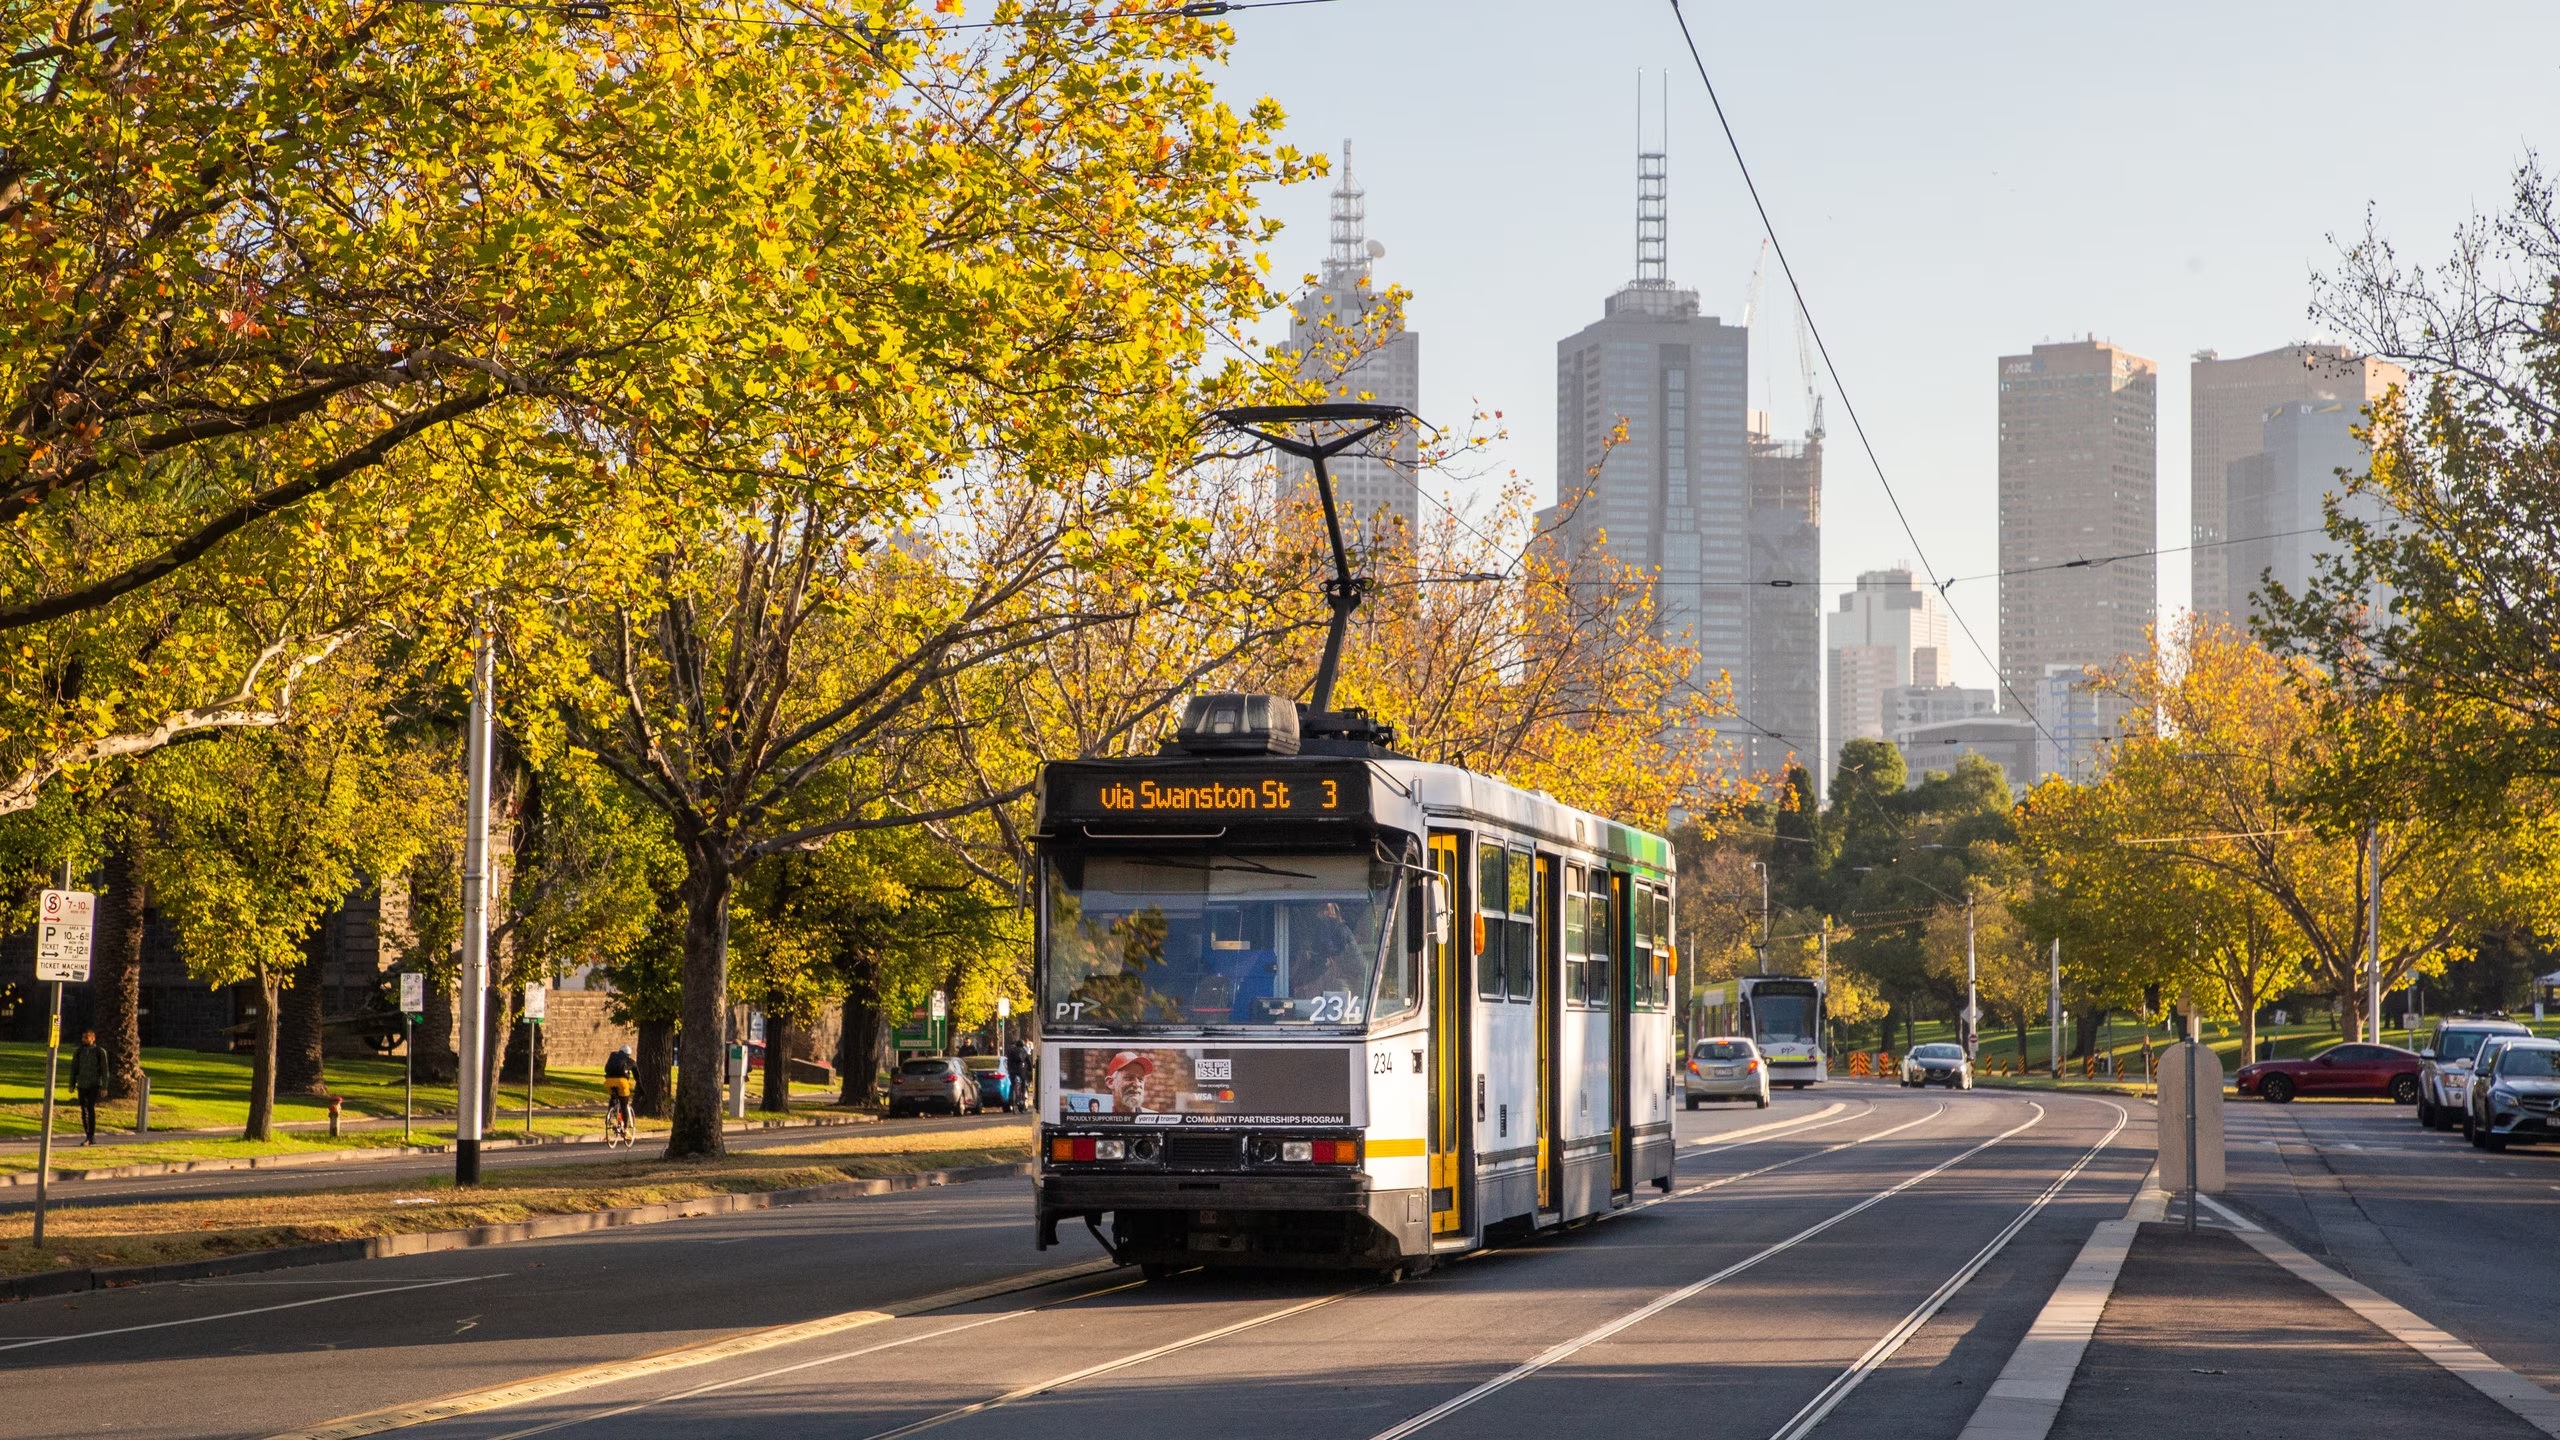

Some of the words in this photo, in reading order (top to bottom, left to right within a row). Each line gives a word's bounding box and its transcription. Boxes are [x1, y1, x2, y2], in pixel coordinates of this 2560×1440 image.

[2005, 362, 2032, 374] ANZ
[1101, 782, 1134, 809] via
[1140, 780, 1256, 809] Swanston
[1262, 780, 1291, 809] St
[1321, 780, 1337, 809] 3
[46, 926, 56, 942] P
[1309, 995, 1361, 1022] 234
[1373, 1051, 1393, 1074] 234
[1198, 1067, 1229, 1078] ISSUE
[1194, 1093, 1213, 1101] VISA
[1185, 1115, 1238, 1124] COMMUNITY
[1238, 1115, 1301, 1124] PARTNERSHIPS
[1301, 1115, 1344, 1124] PROGRAM
